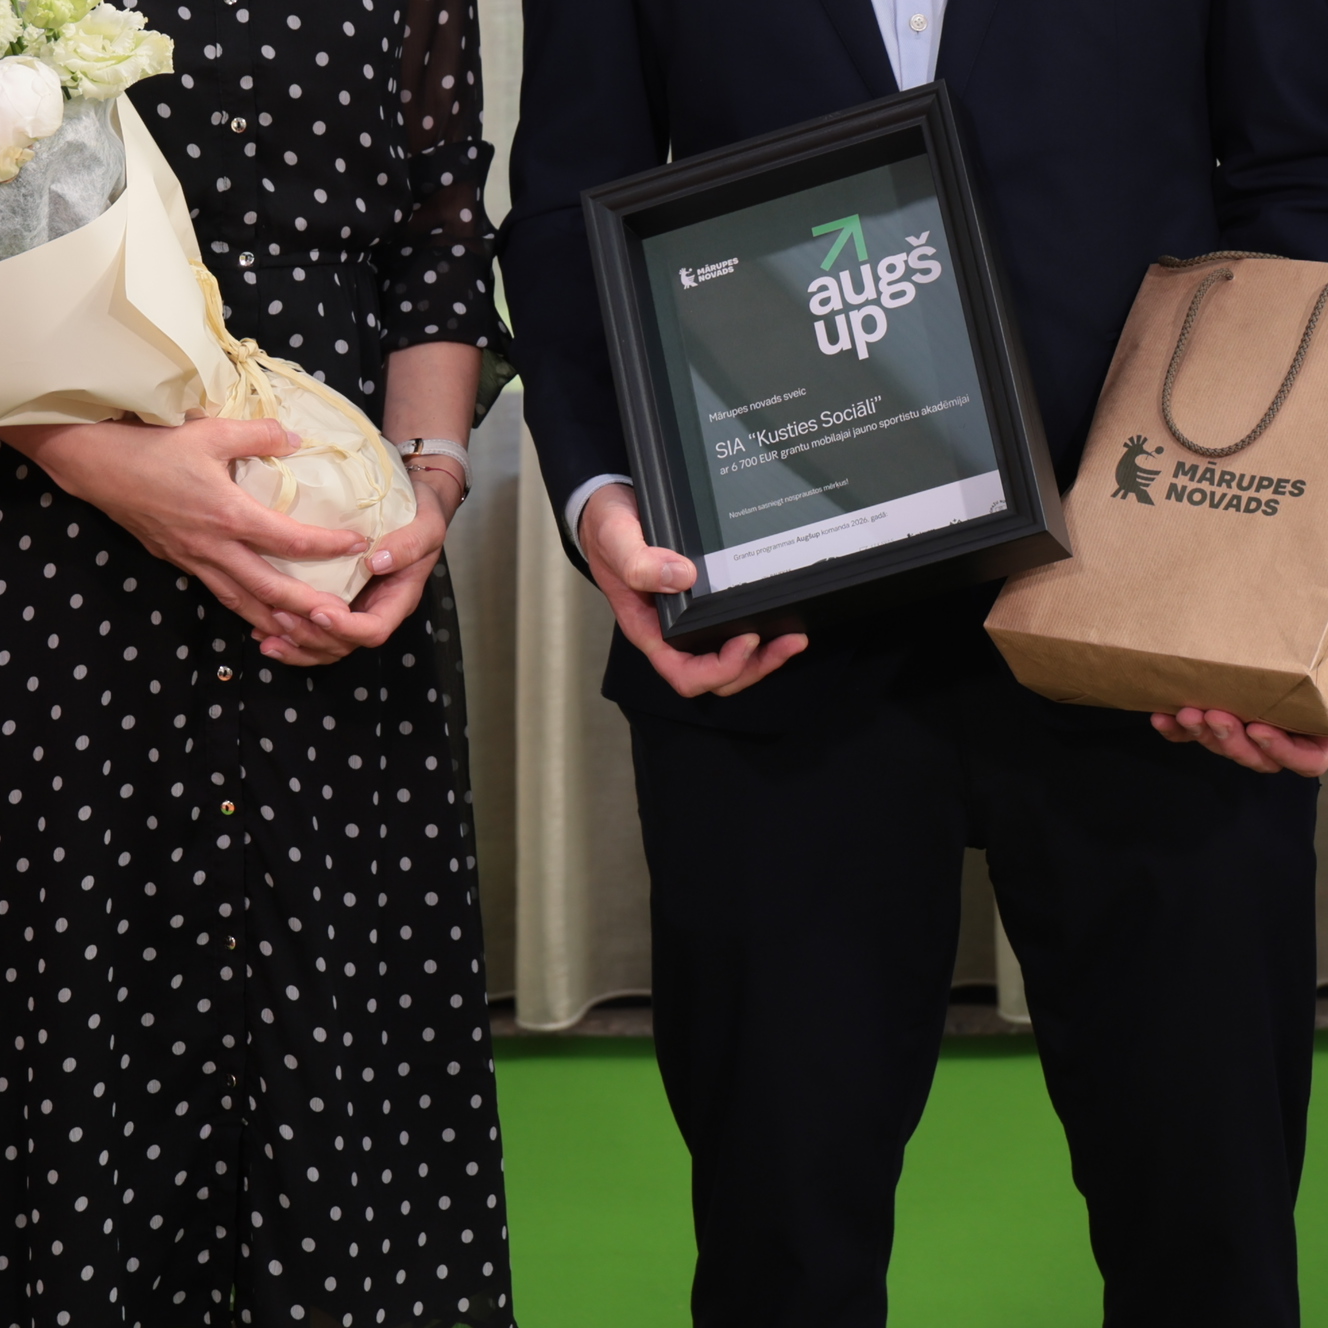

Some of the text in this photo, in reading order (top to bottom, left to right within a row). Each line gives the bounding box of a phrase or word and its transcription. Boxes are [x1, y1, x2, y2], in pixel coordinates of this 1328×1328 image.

[696, 257, 739, 276] MĀRUPES
[698, 266, 734, 282] NOVADS
[807, 230, 942, 316] augš
[813, 304, 888, 361] up
[708, 387, 807, 423] Mārupes novads sveic
[715, 395, 882, 459] SIA “Kusties Sociāli”
[719, 393, 970, 475] ar 6 700 EUR grantu mobilajai jauno sportistu akadēmijai
[1172, 460, 1307, 498] MĀRUPES
[728, 505, 758, 519] Novēlam
[757, 498, 784, 511] sasniegt
[784, 487, 823, 503] nospraustos
[1165, 482, 1280, 517] NOVADS
[733, 548, 755, 561] Grantu
[756, 539, 795, 556] programmas
[796, 530, 821, 544] Augšup
[821, 522, 850, 535] komanda
